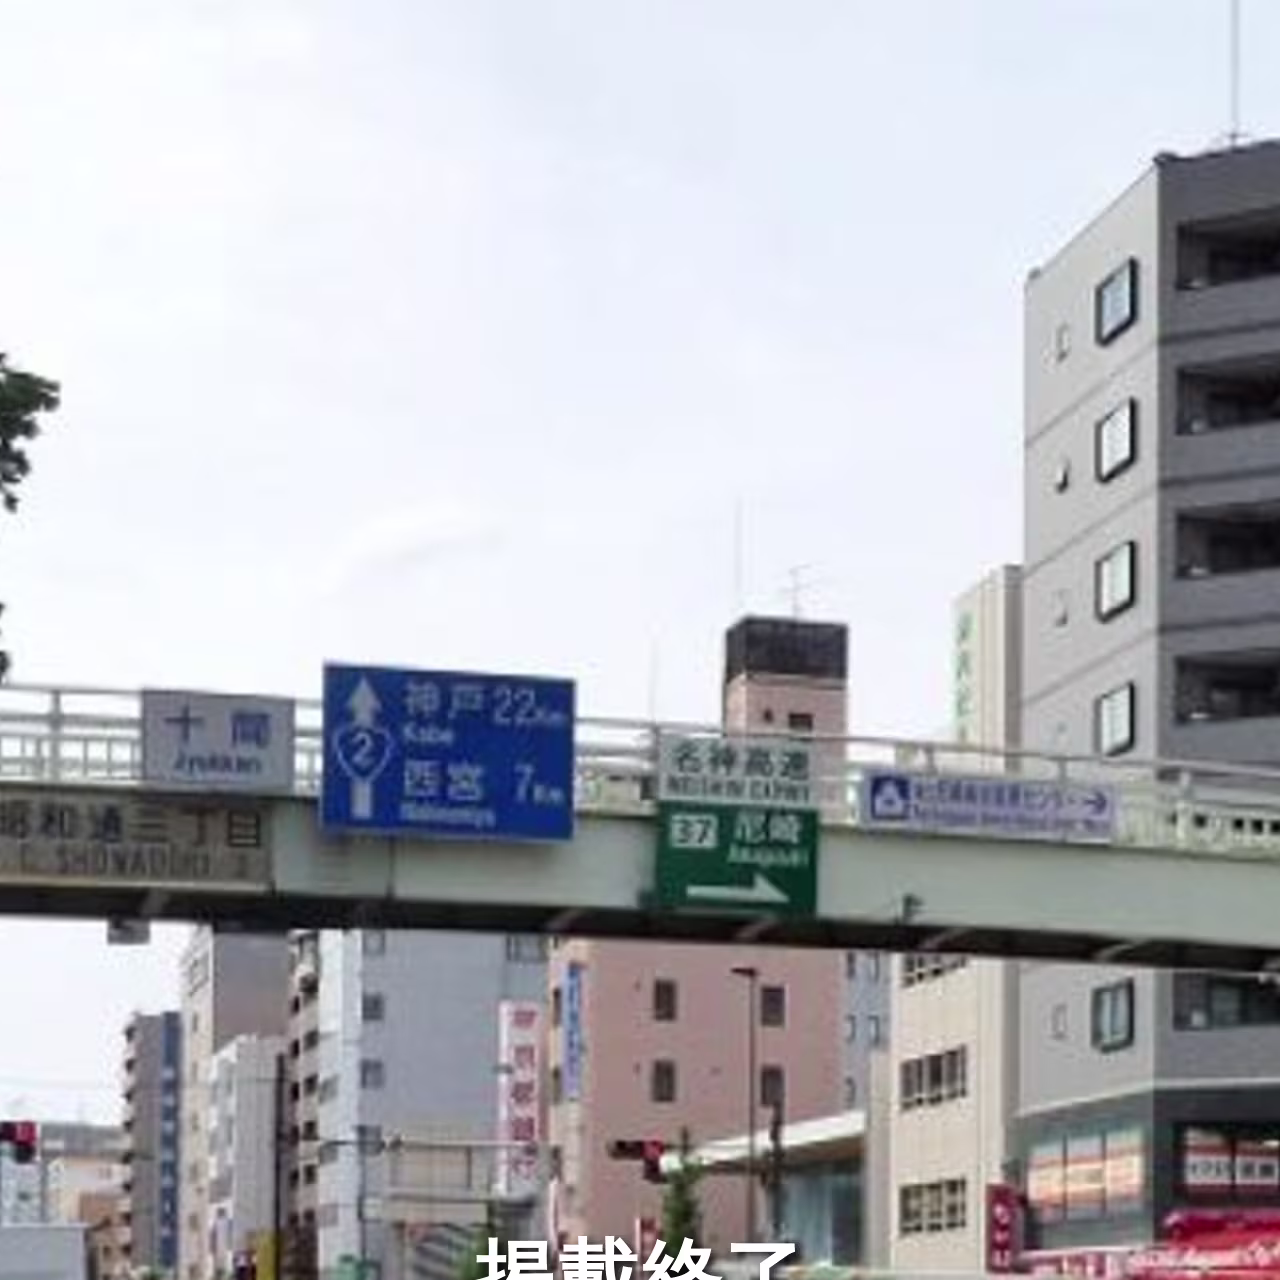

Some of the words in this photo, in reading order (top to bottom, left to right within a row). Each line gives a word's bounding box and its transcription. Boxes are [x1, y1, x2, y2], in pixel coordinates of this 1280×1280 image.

[403, 681, 484, 719] 神戸
[163, 703, 270, 747] 十間
[403, 721, 453, 744] Kobe
[351, 731, 372, 766] 2
[676, 738, 810, 781] 名神高速
[404, 759, 484, 802] 西宮
[677, 818, 713, 844] 37
[734, 811, 802, 844] 尼崎
